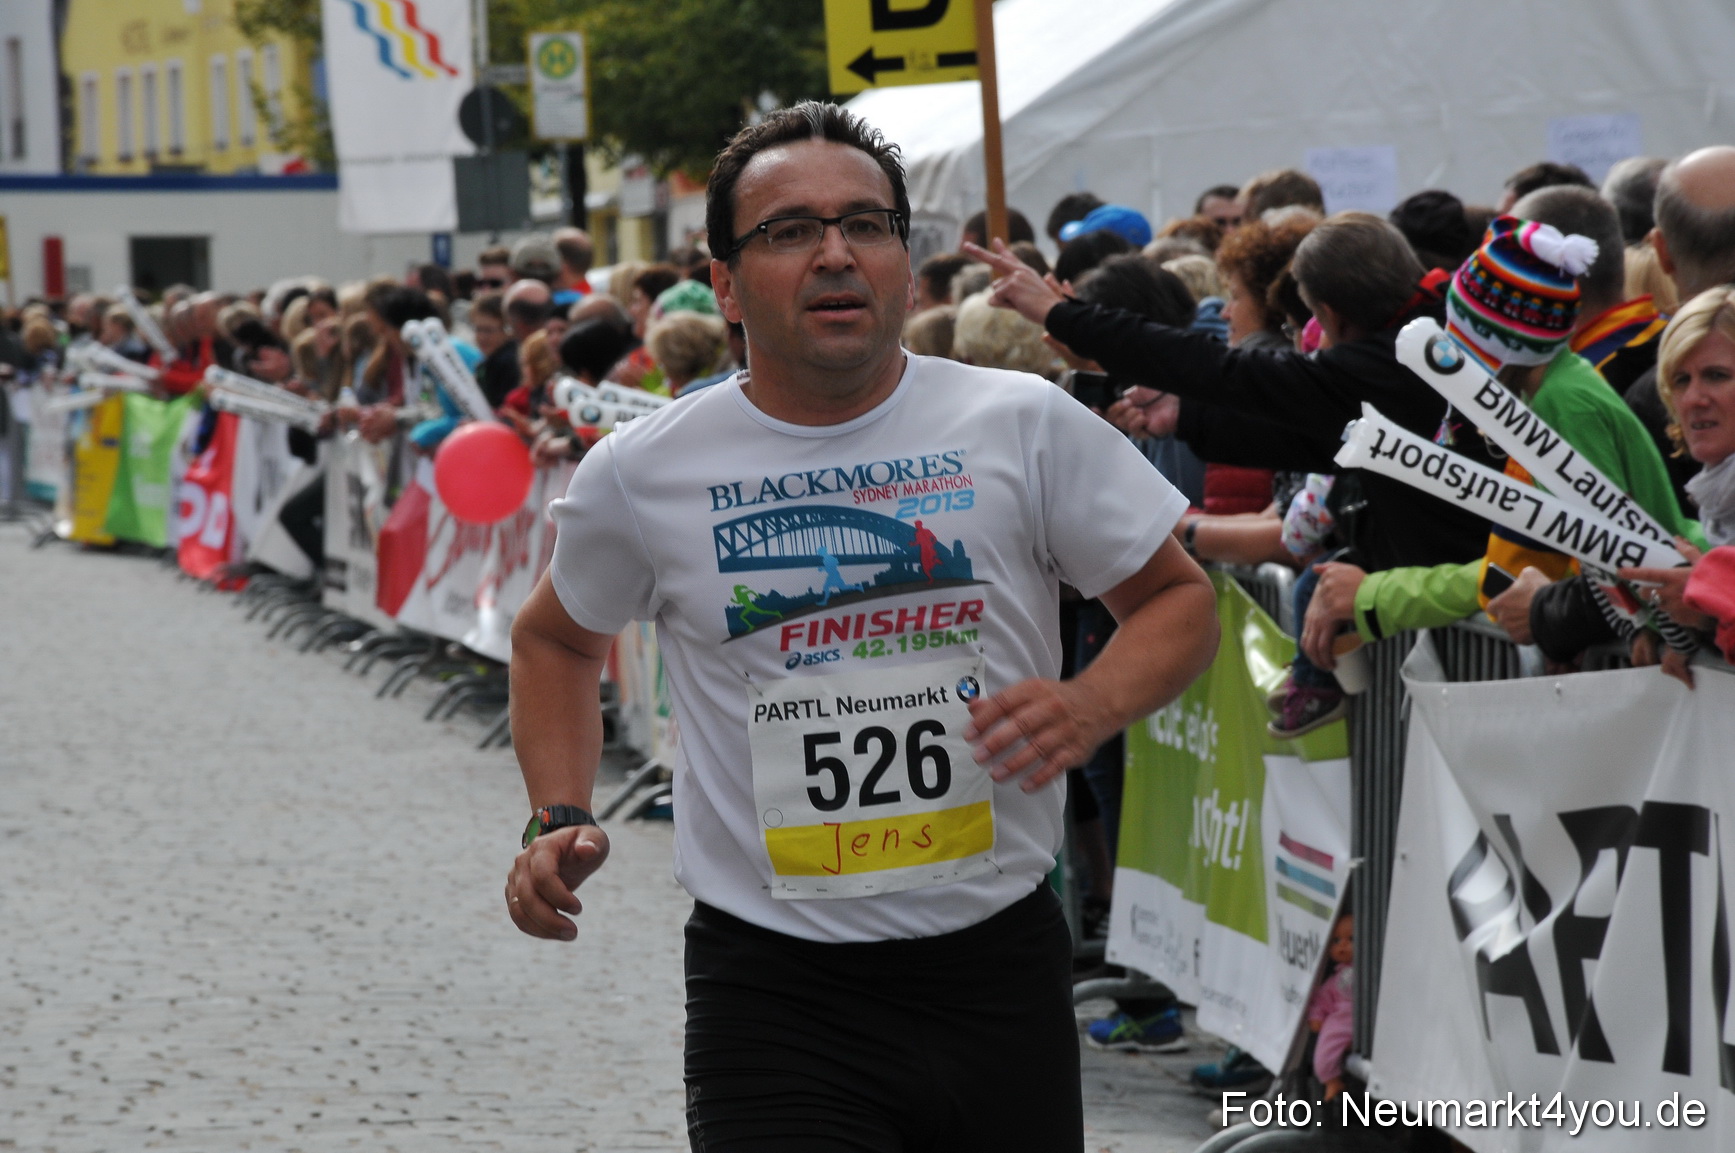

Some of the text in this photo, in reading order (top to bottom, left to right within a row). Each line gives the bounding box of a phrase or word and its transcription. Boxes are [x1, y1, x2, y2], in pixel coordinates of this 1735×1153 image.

[1474, 378, 1561, 458] BMW
[852, 475, 973, 505] SYDNEY MARATHON
[894, 490, 976, 519] 2013
[1369, 428, 1648, 569] BMW Laufsport
[779, 599, 985, 652] FINISHER
[852, 629, 979, 660] 42.195km
[753, 698, 830, 723] PARTL
[836, 686, 949, 717] Neumarkt
[803, 719, 952, 812] 526
[821, 822, 933, 875] Jens
